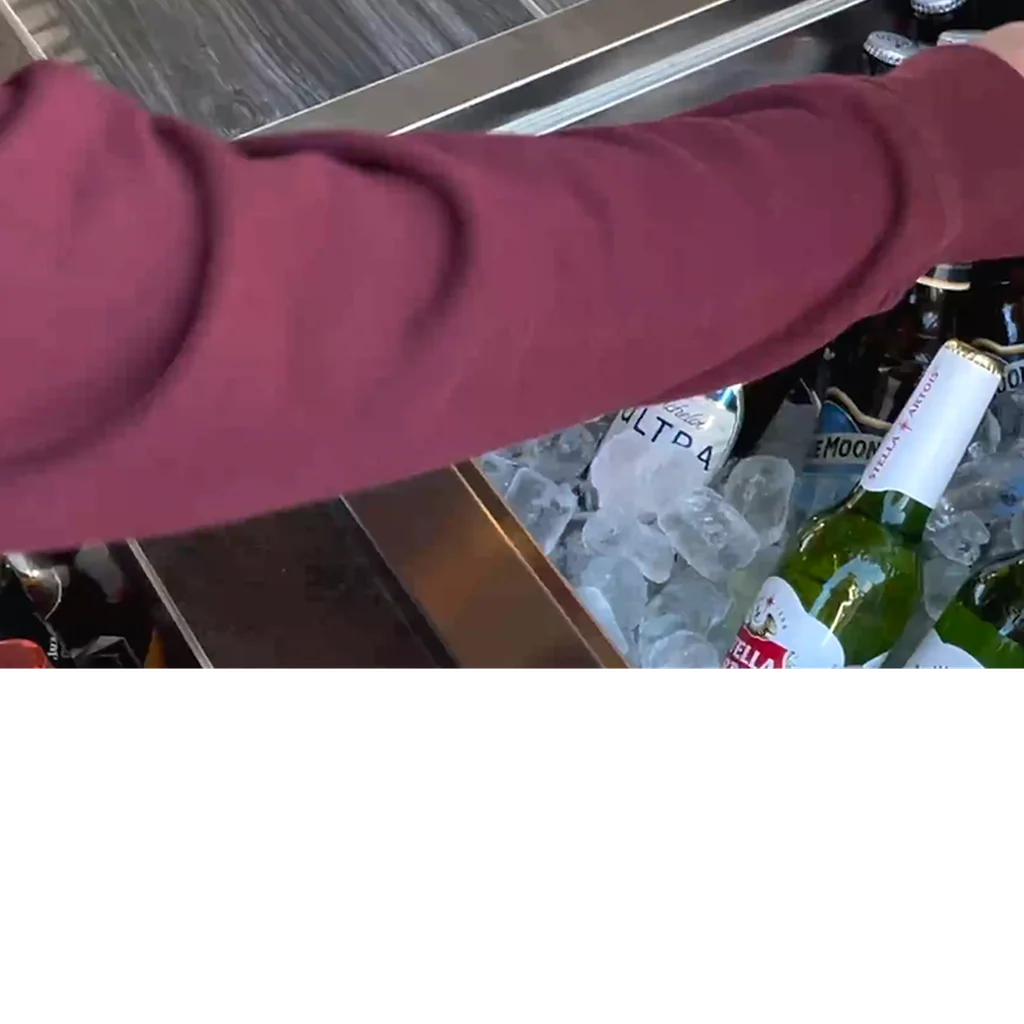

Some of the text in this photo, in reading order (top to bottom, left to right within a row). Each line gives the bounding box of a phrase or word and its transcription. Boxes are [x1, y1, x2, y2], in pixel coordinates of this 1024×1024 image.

[868, 370, 939, 480] STELLA ARTOIS
[823, 436, 882, 460] MOON
[730, 638, 776, 672] ELLA
